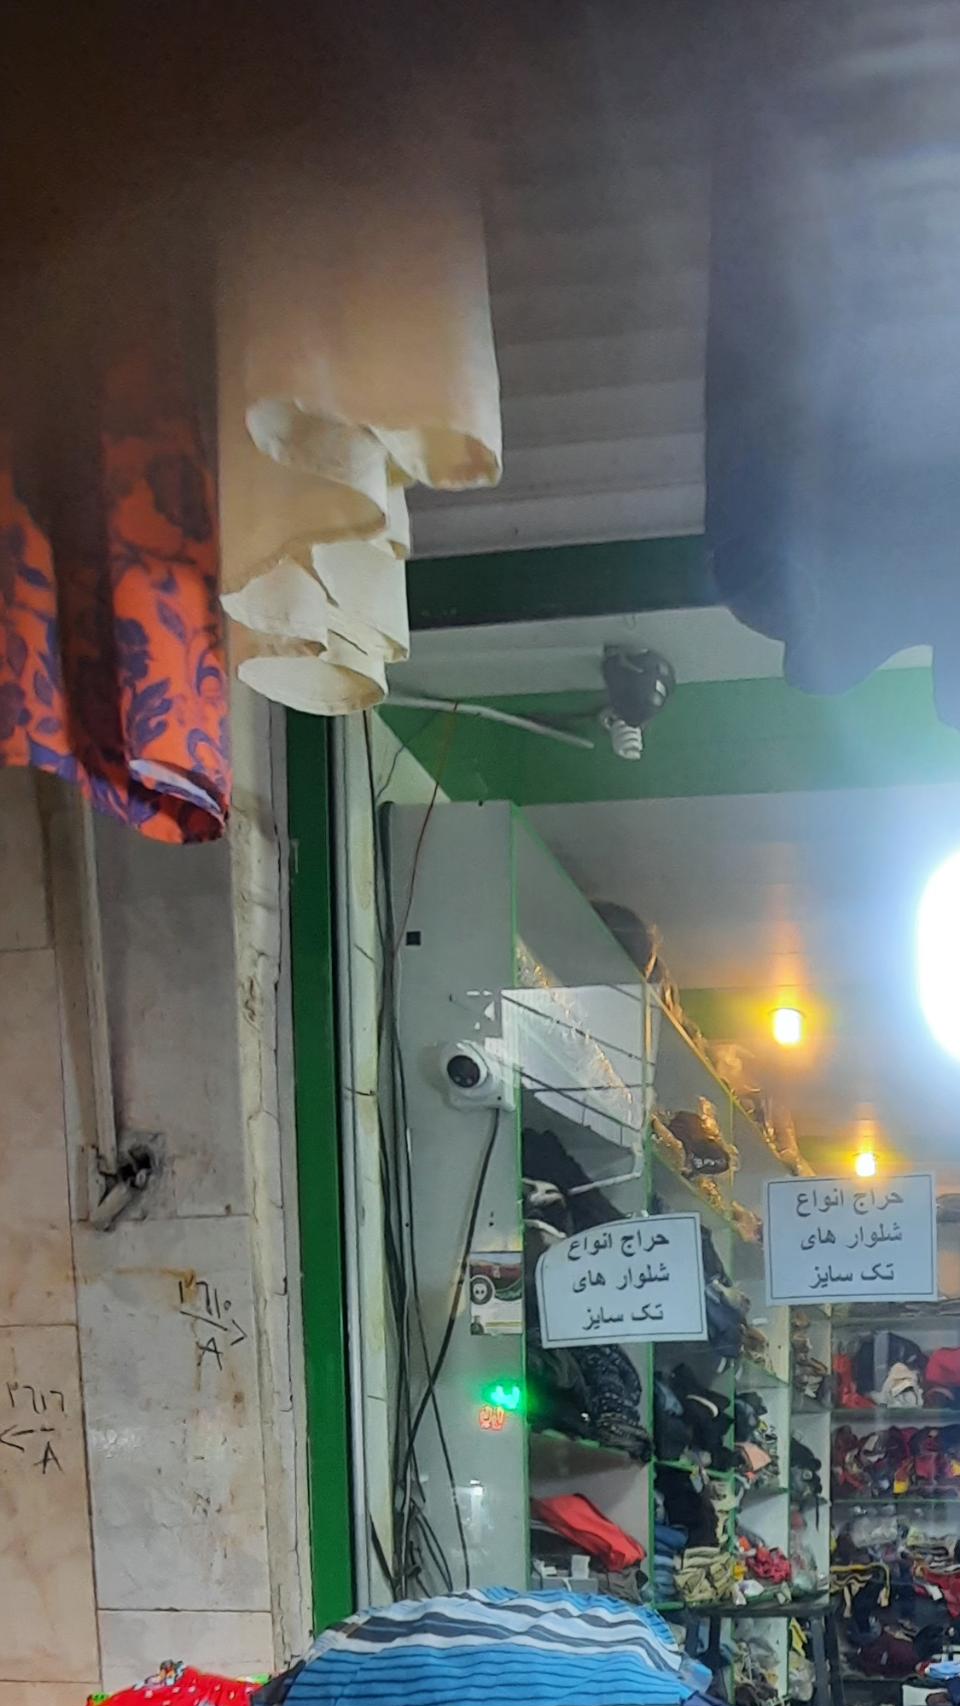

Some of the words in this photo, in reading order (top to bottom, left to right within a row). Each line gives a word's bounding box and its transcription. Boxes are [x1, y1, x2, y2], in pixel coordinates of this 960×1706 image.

[796, 1188, 844, 1217] انواع
[853, 1189, 904, 1215] حراج
[567, 1232, 613, 1261] انواع
[621, 1229, 670, 1257] حراج
[800, 1226, 836, 1251] های
[846, 1222, 903, 1249] شلوار
[572, 1269, 606, 1293] های
[616, 1263, 670, 1290] شلوار
[808, 1265, 853, 1289] سایز
[860, 1263, 894, 1281] تک
[582, 1306, 624, 1331] سایز
[631, 1303, 664, 1321] تک
